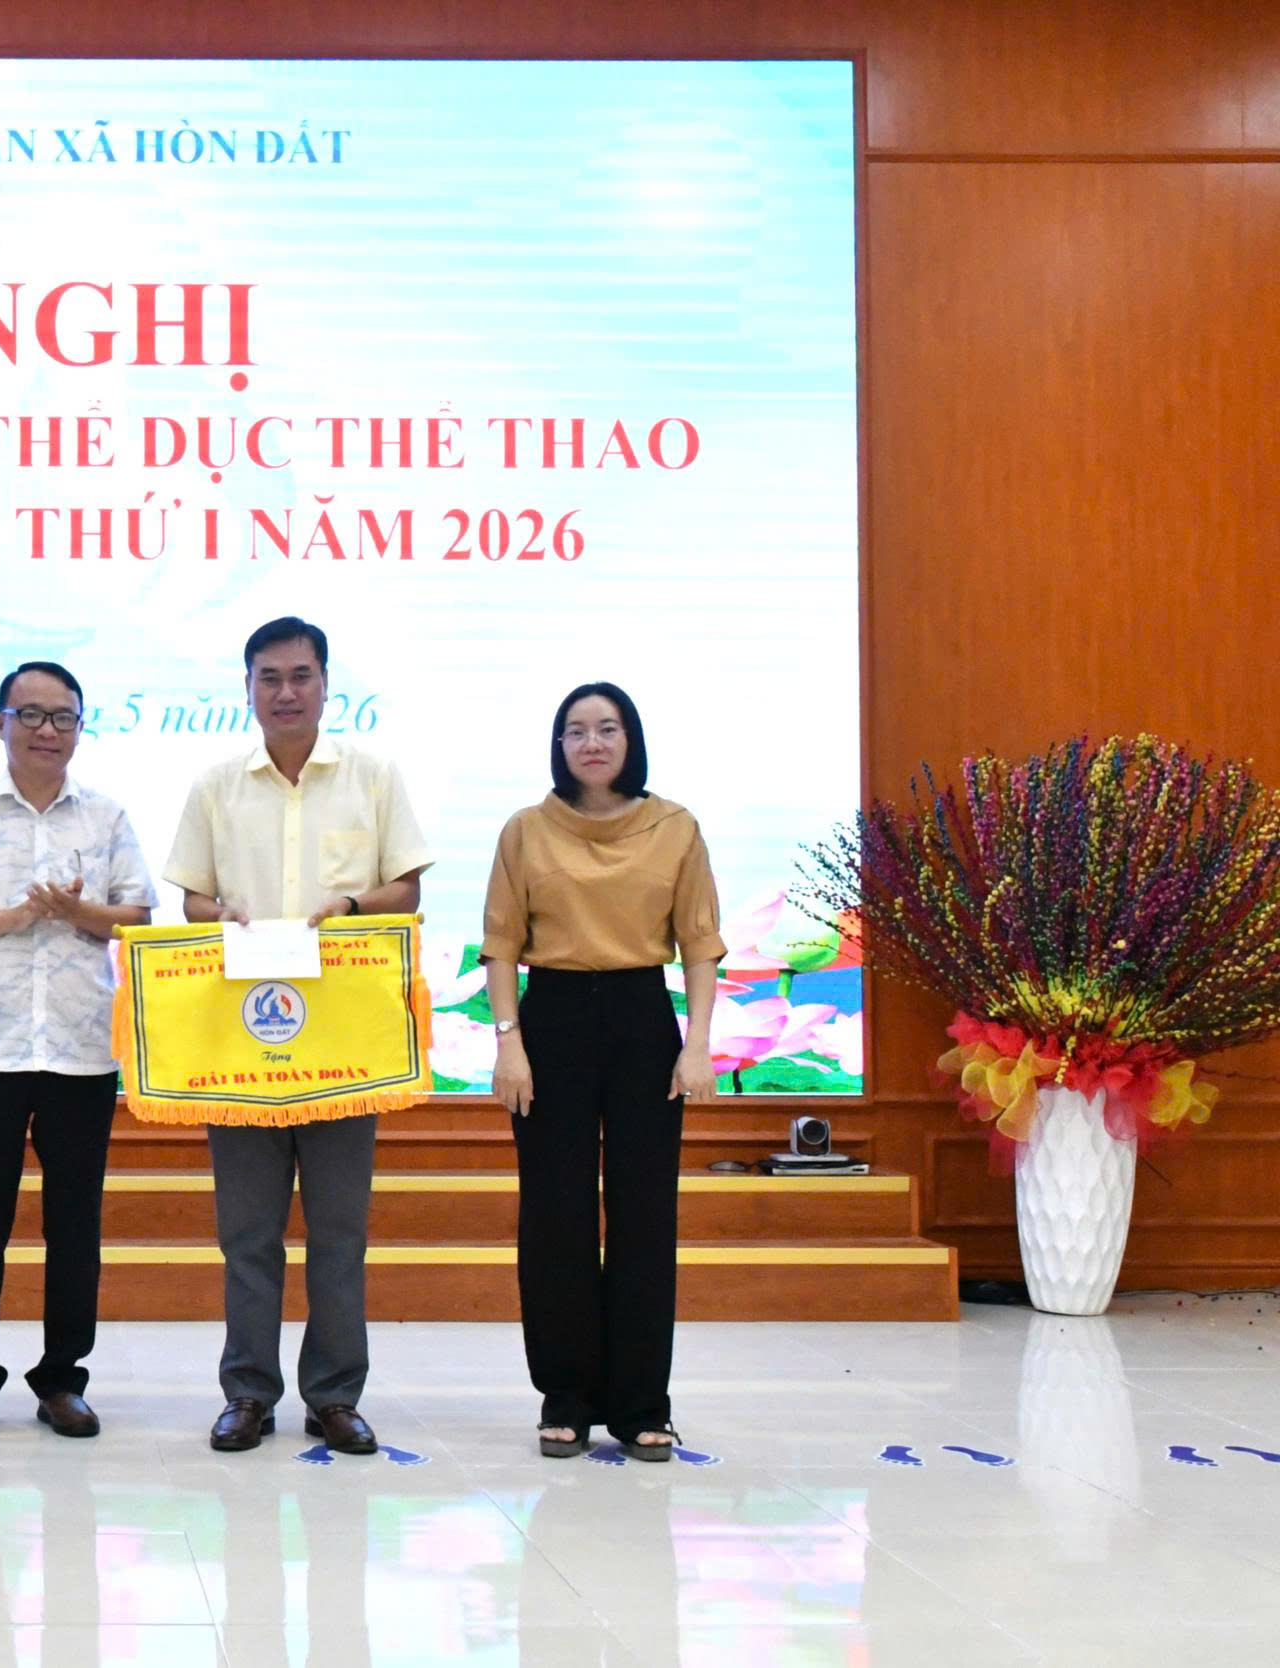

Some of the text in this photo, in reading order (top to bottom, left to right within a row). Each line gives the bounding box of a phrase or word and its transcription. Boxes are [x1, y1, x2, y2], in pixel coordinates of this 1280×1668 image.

[53, 119, 117, 163] XÃ
[134, 118, 237, 164] HÒN
[142, 416, 293, 484] DỤC
[315, 400, 466, 469] THỂ
[487, 417, 701, 470] THAO
[15, 490, 183, 561] THỨ
[203, 508, 220, 560] I
[249, 494, 417, 561] NĂM
[442, 508, 586, 561] 2026
[119, 692, 145, 733] 5
[159, 694, 253, 733] năm
[325, 693, 378, 733] 26
